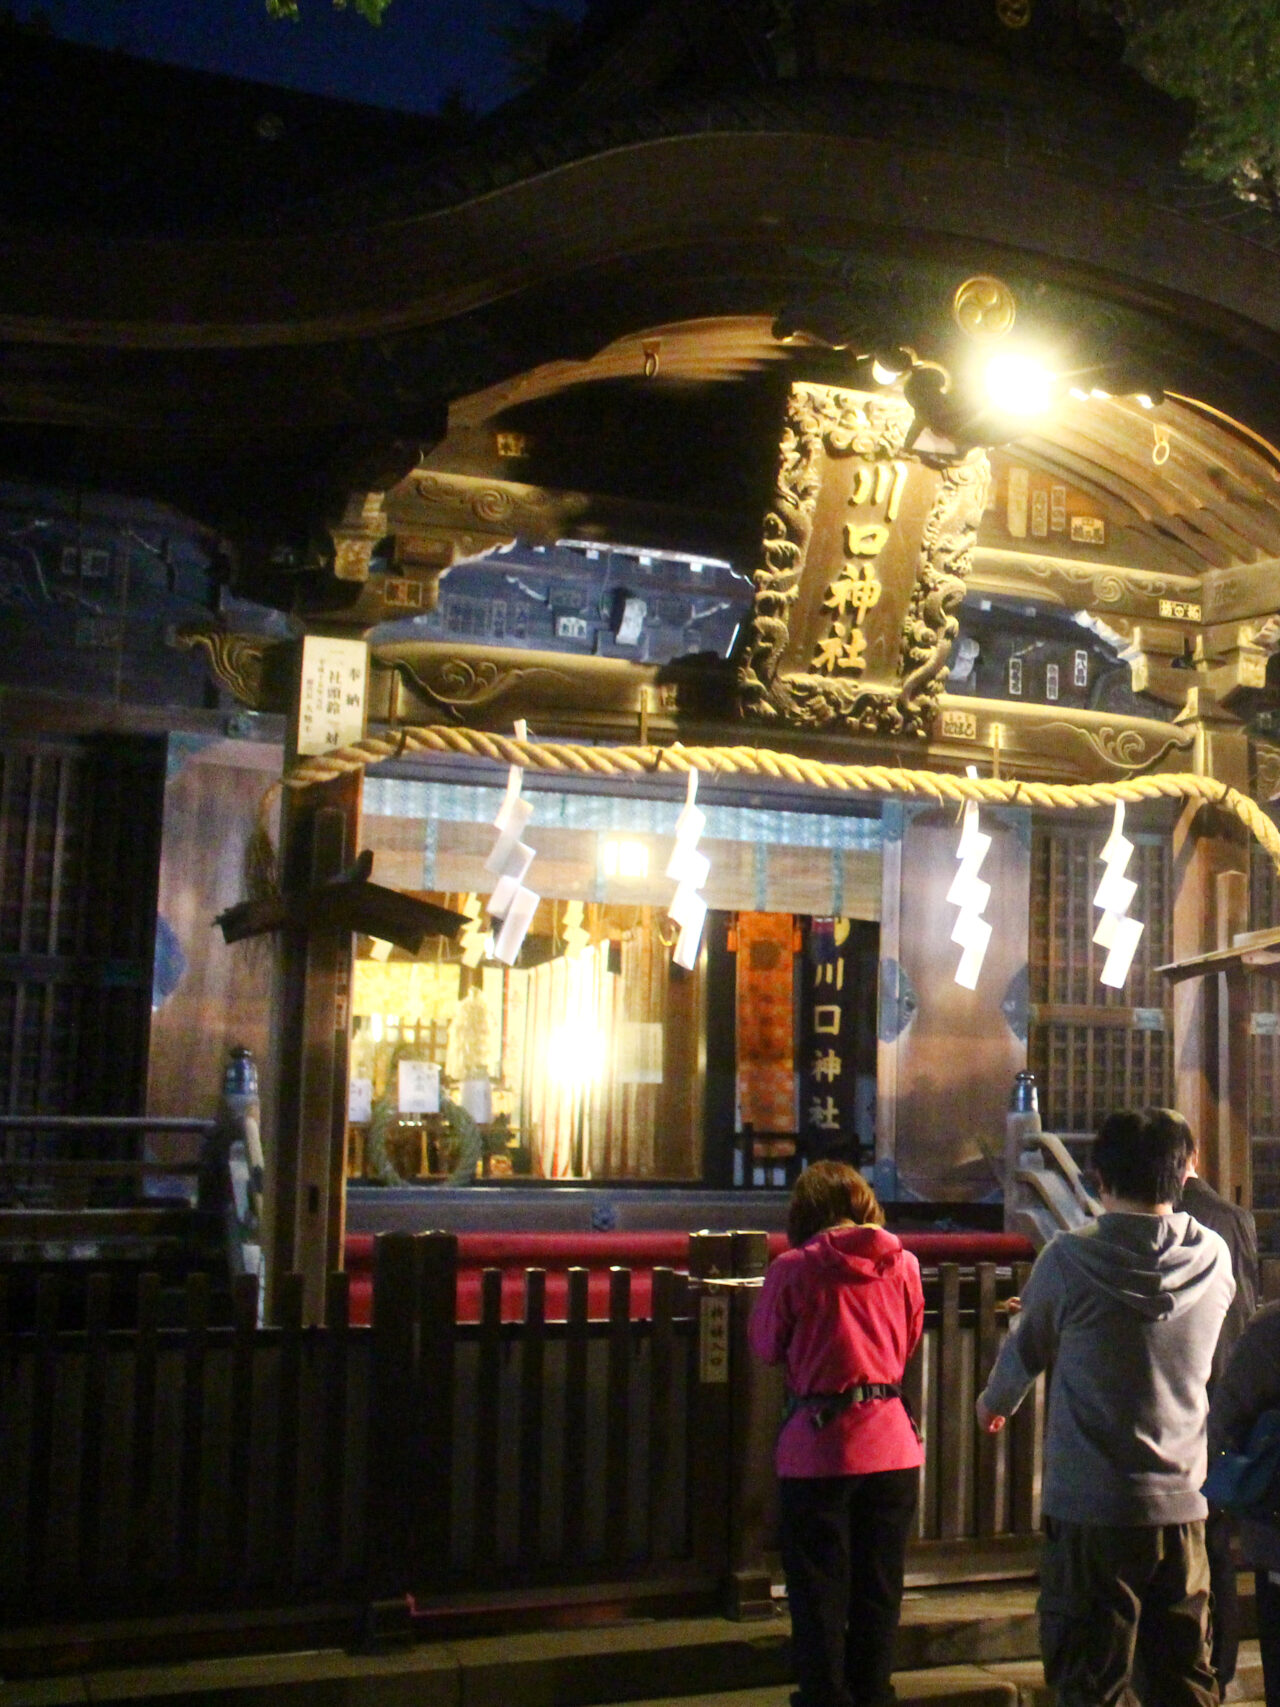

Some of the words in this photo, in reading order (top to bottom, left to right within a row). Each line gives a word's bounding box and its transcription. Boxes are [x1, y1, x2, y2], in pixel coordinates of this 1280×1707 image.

[812, 461, 908, 672] 川口神社
[809, 957, 845, 1129] 川口神社
